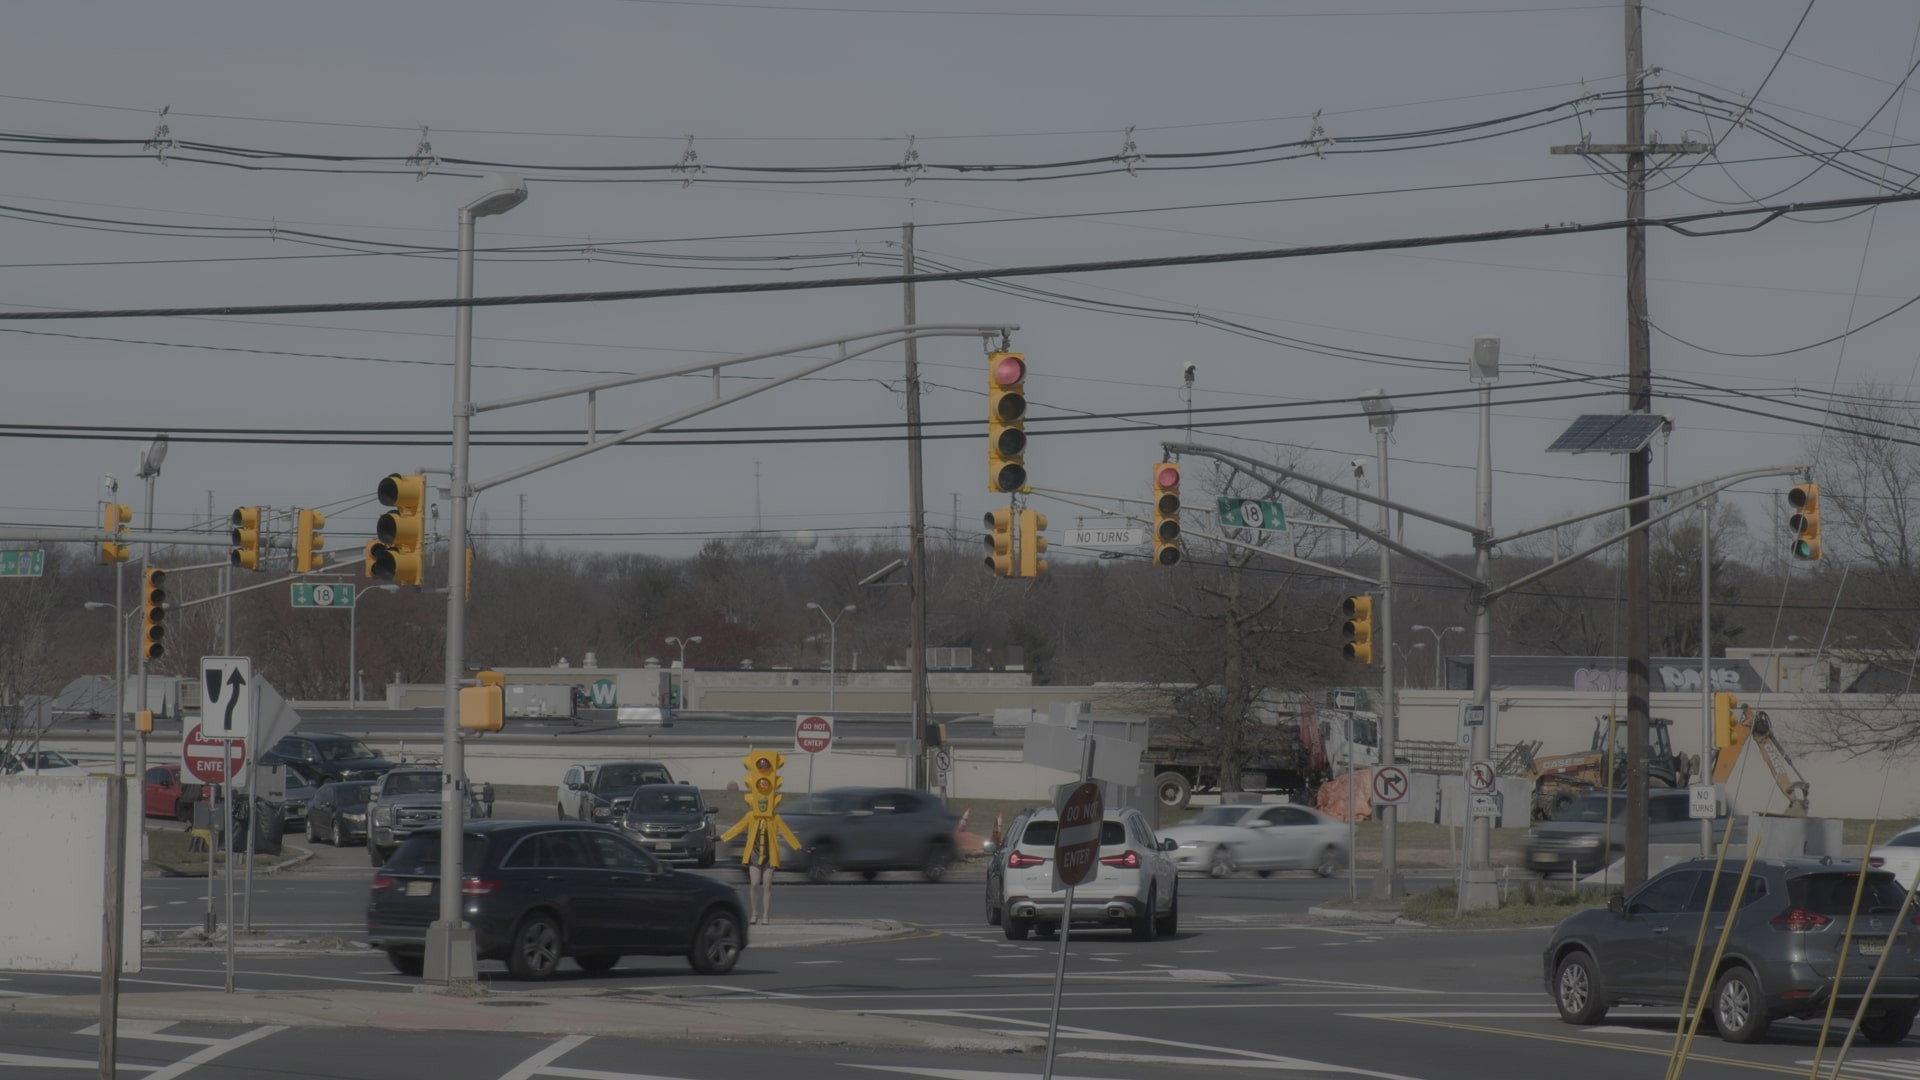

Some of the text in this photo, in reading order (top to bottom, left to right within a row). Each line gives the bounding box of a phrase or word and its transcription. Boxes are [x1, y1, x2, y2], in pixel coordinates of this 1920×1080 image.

[1244, 505, 1260, 521] 18
[1076, 531, 1129, 543] NO TURNS
[317, 589, 329, 601] 18
[592, 684, 616, 704] W
[803, 739, 824, 747] ENTER
[196, 760, 224, 772] ENTE
[1697, 791, 1709, 800] NO
[1067, 801, 1098, 821] DO NOT
[1692, 804, 1713, 812] TURNS
[1064, 847, 1090, 868] ENTER
